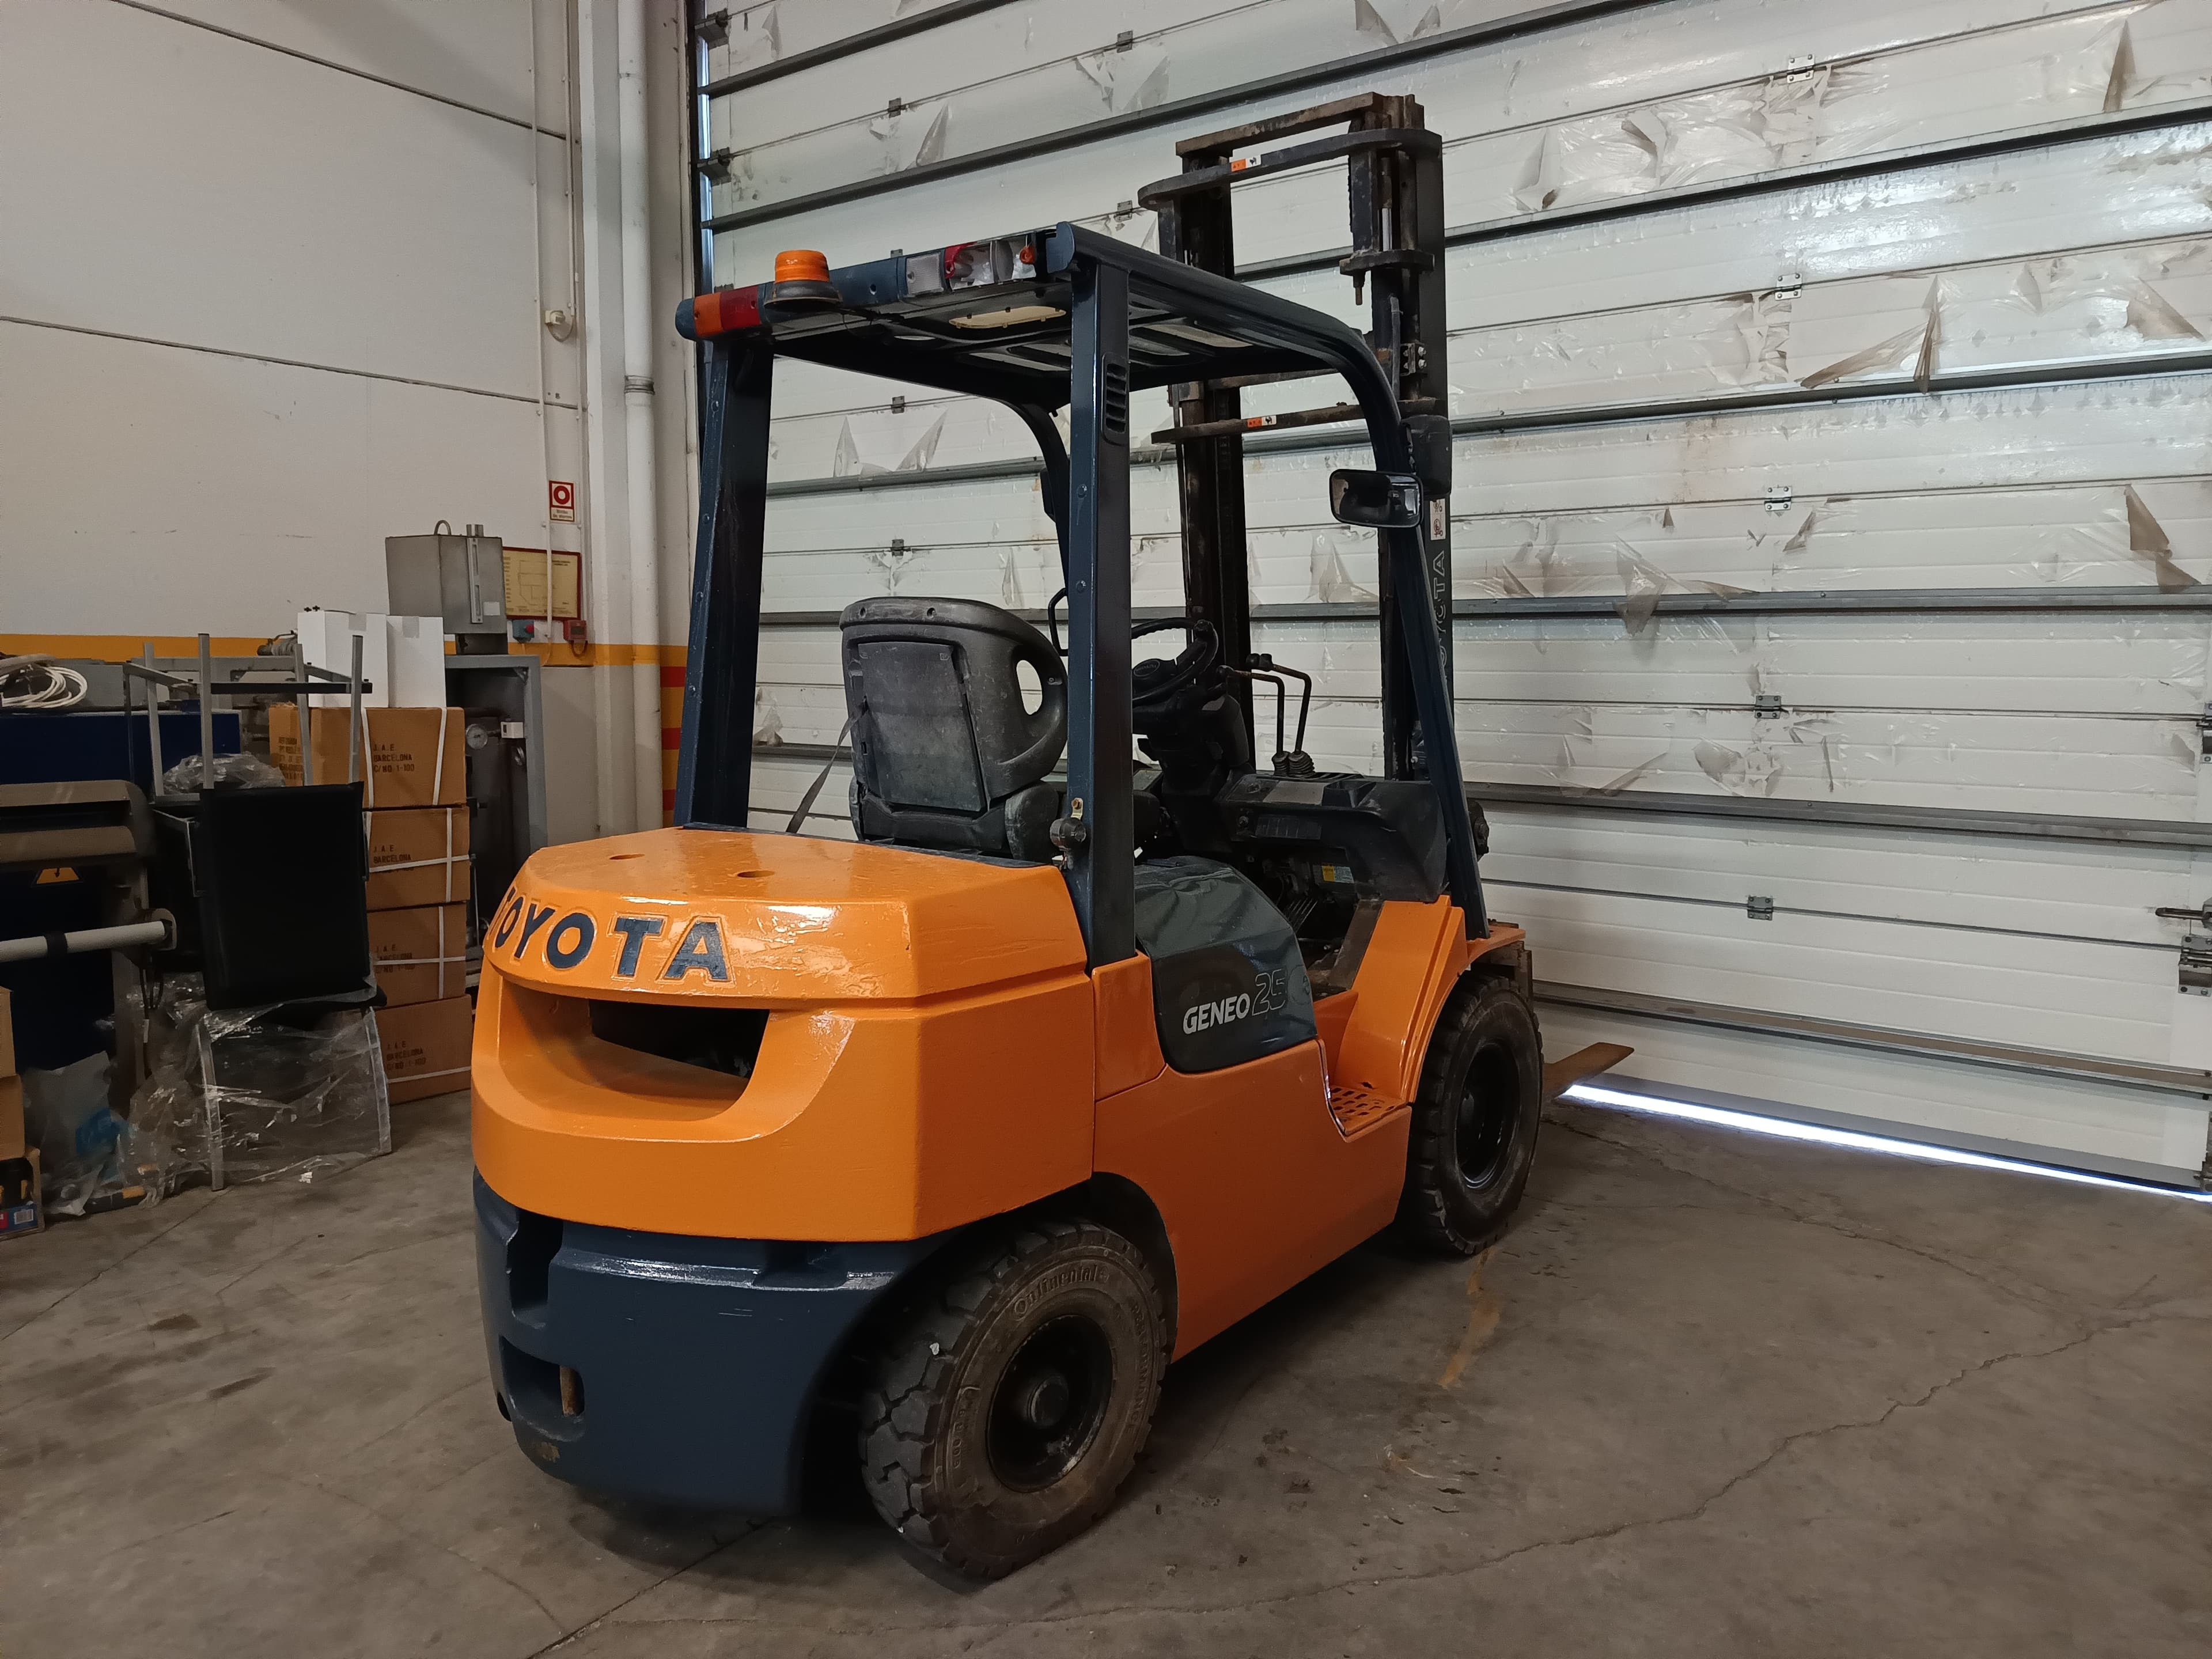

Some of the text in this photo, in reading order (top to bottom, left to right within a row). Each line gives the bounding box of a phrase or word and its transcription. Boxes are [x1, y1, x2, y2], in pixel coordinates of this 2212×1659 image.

[373, 753, 412, 762] BARCELONA
[373, 854, 411, 864] BARCELONA
[488, 885, 729, 982] TOYOTA
[1183, 993, 1251, 1035] GENEO
